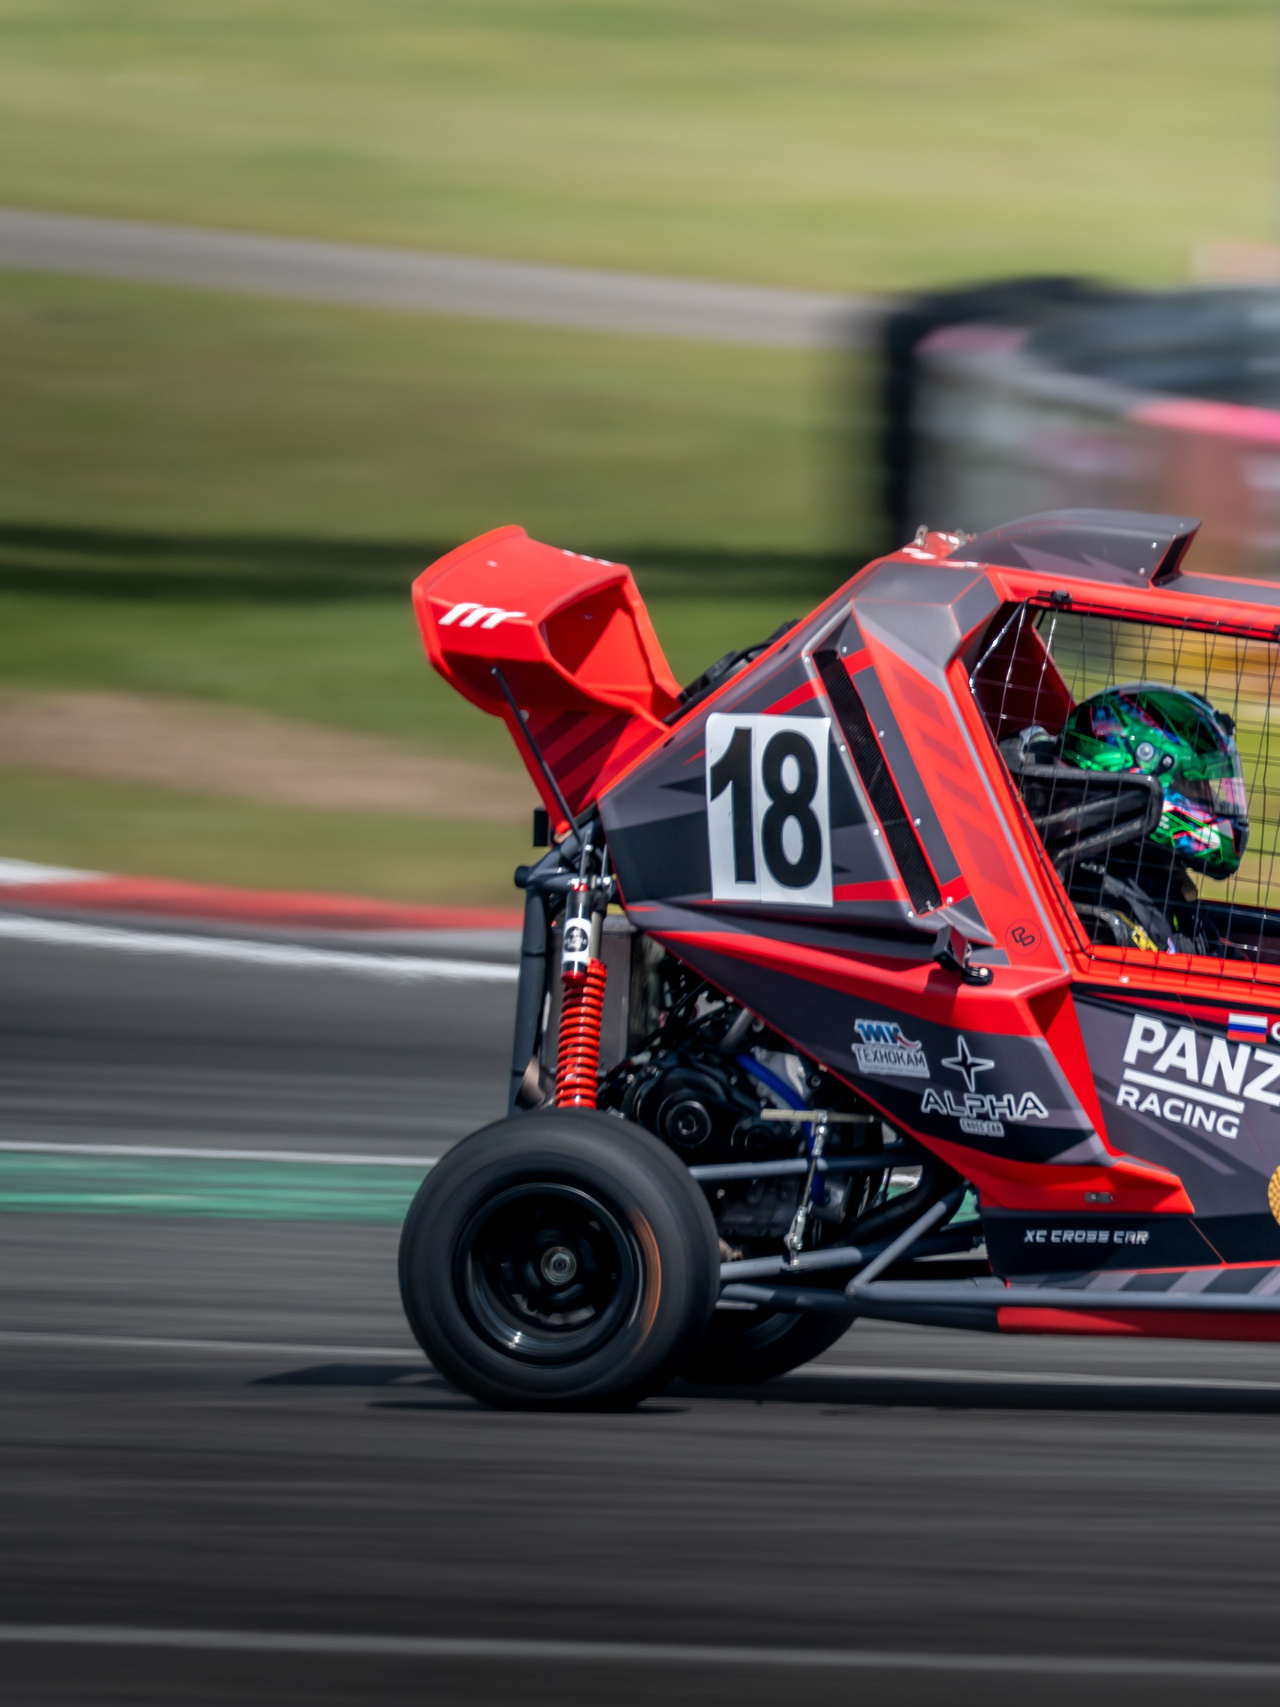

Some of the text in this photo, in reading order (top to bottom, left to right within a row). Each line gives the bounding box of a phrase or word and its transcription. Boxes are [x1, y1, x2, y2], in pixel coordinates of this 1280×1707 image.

[710, 727, 822, 888] 18
[921, 1088, 1049, 1121] ALPHA
[1116, 1083, 1240, 1140] RACING
[1024, 1230, 1149, 1244] XC CROSS CAR
